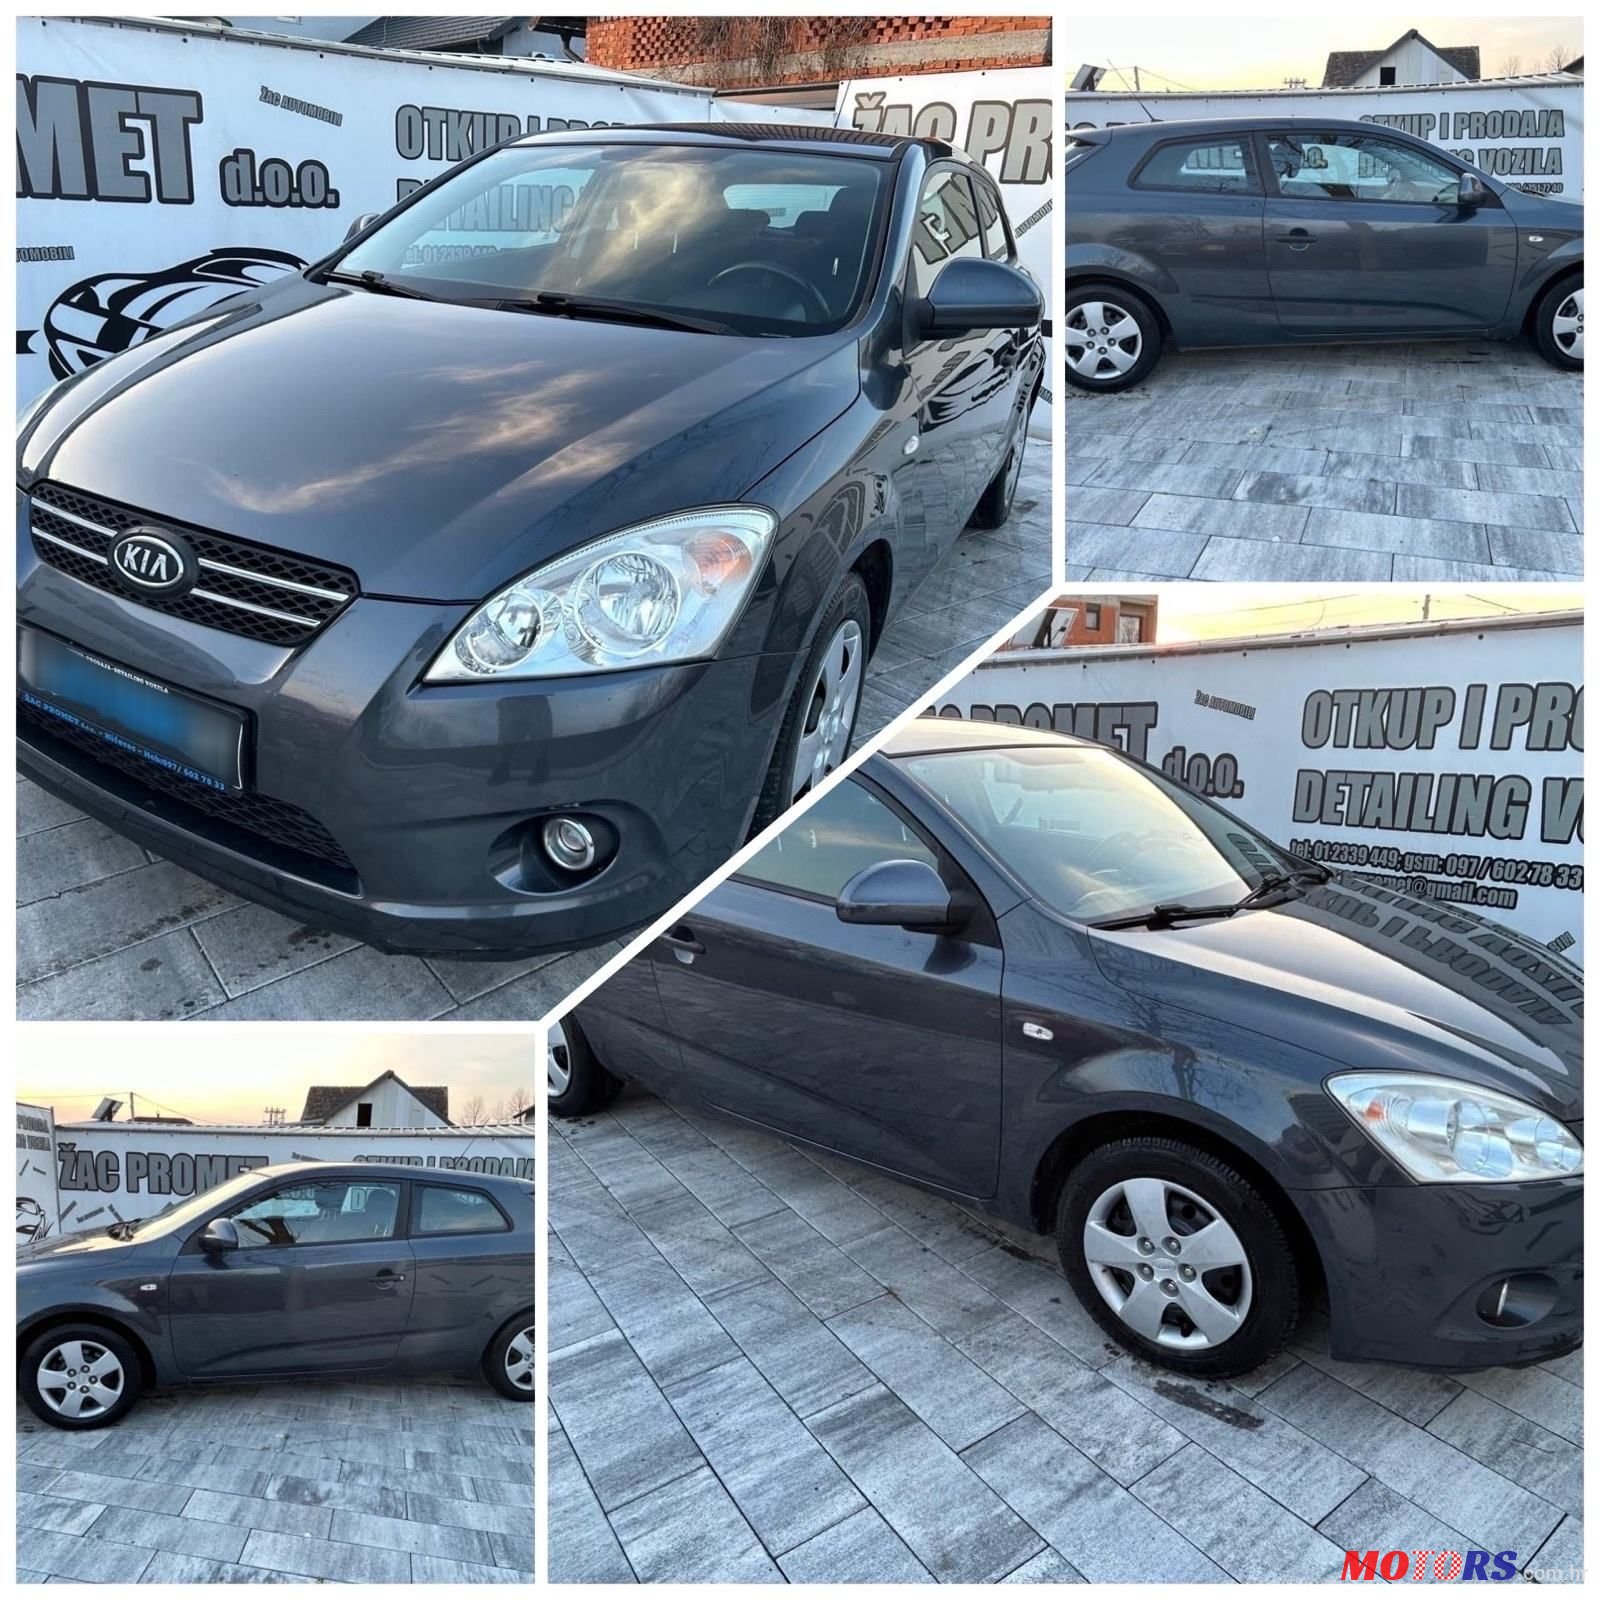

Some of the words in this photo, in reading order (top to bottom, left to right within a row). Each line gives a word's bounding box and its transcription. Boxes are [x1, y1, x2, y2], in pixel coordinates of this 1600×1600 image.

[259, 85, 281, 106] ŽAC
[280, 95, 343, 127] AUTOMOBILI
[1453, 110, 1565, 139] PRODAJA
[965, 99, 1053, 184] PR
[1478, 147, 1563, 176] VOZILA
[219, 148, 340, 208] d.o.o.
[123, 543, 167, 581] KIA
[1208, 696, 1256, 720] AUTOMOBILI
[1302, 686, 1456, 750] OTKUP
[1458, 684, 1487, 749] I
[1293, 769, 1531, 840] DETAILING
[1541, 776, 1584, 844] V
[1403, 852, 1445, 874] gsm:
[1445, 854, 1480, 878] 097
[1490, 858, 1529, 883] 602
[1528, 862, 1554, 887] 78
[57, 1143, 120, 1193] ŽAC
